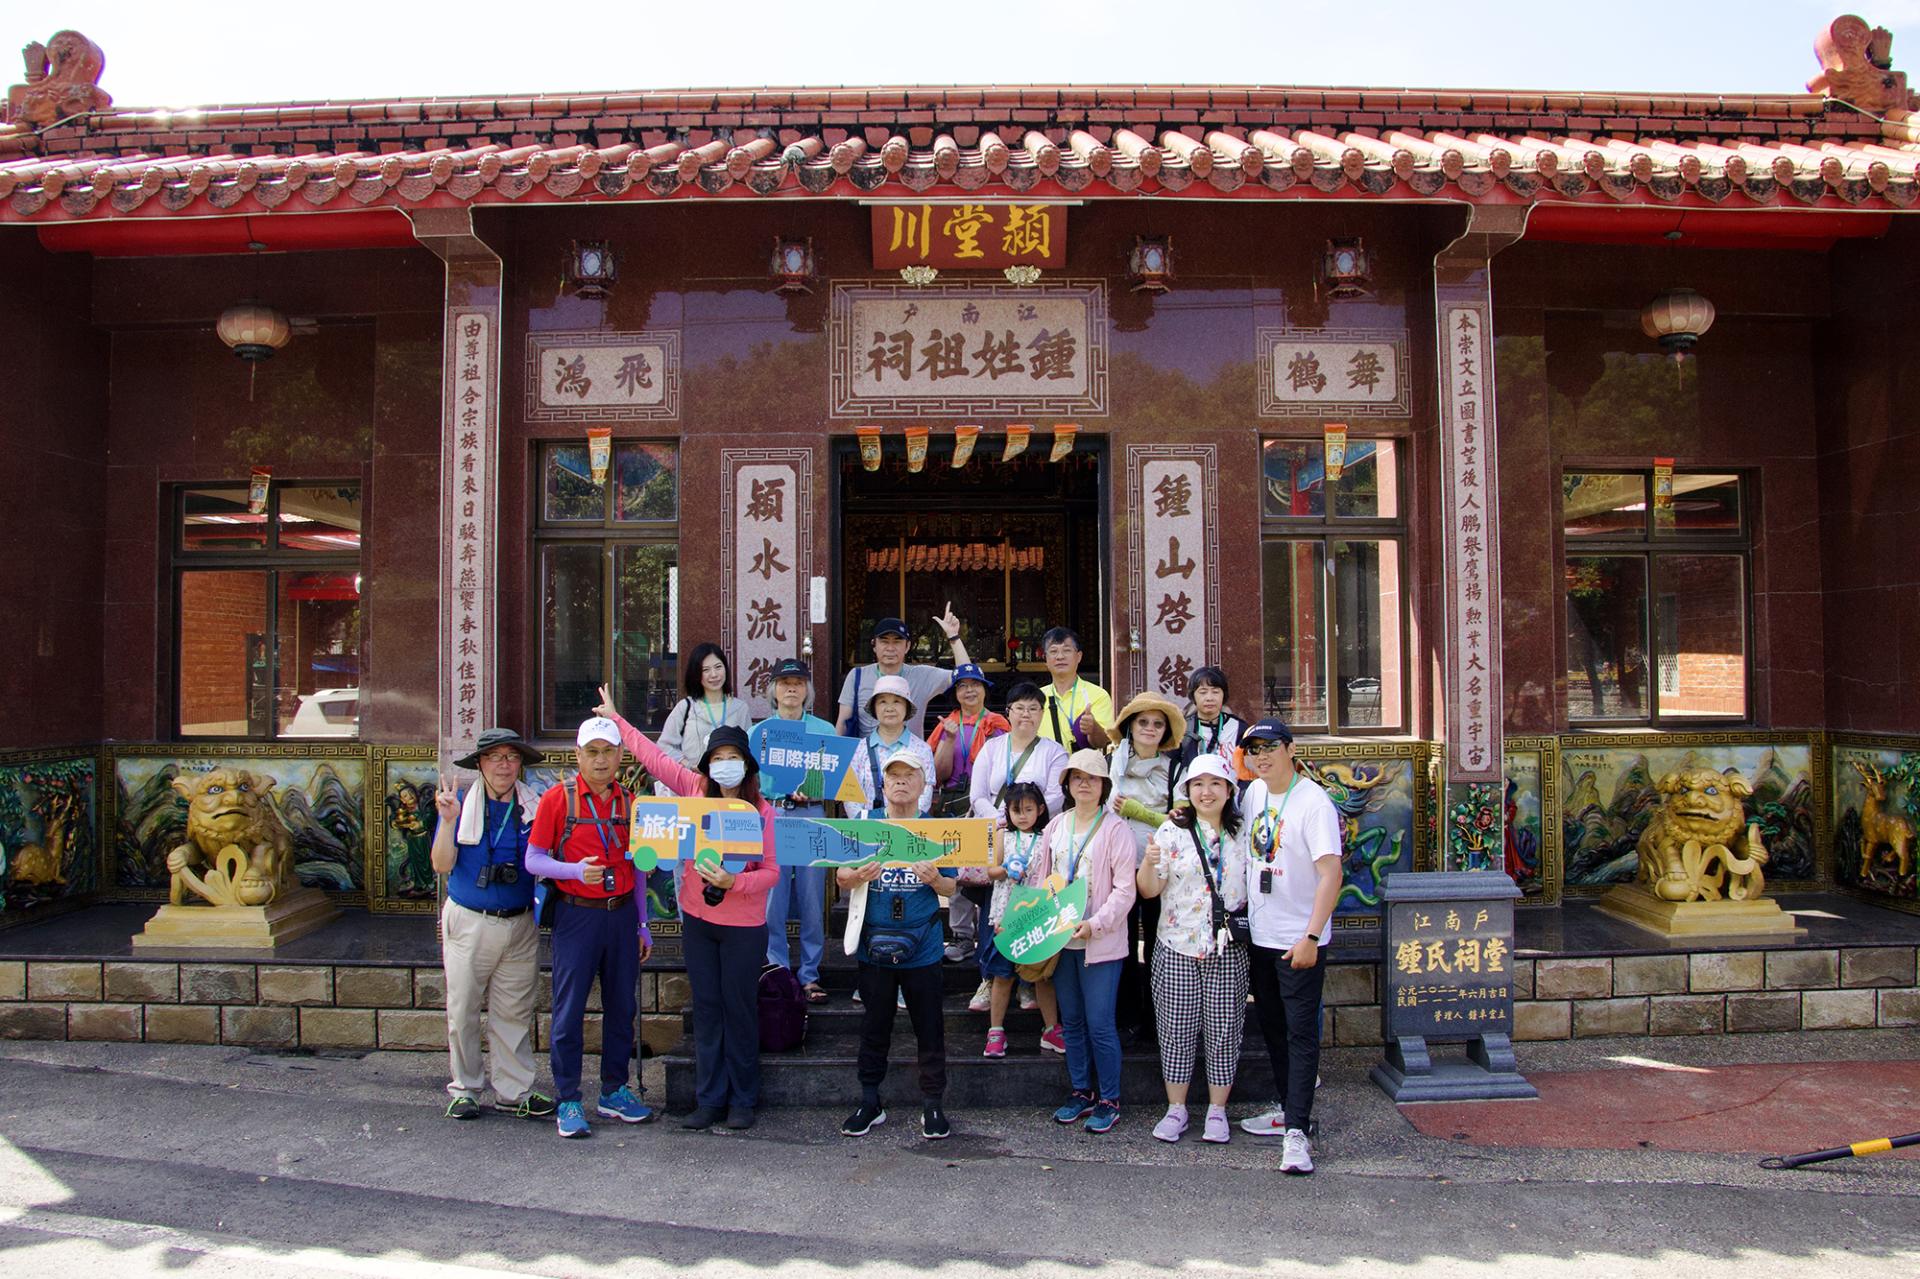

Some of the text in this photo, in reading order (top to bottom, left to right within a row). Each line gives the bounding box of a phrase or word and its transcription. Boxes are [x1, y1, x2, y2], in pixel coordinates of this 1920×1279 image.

[768, 747, 840, 773] 國際視野
[642, 814, 691, 840] 旅行
[1009, 902, 1079, 959] 在地之美
[1395, 936, 1508, 974] 鍾氏祠堂
